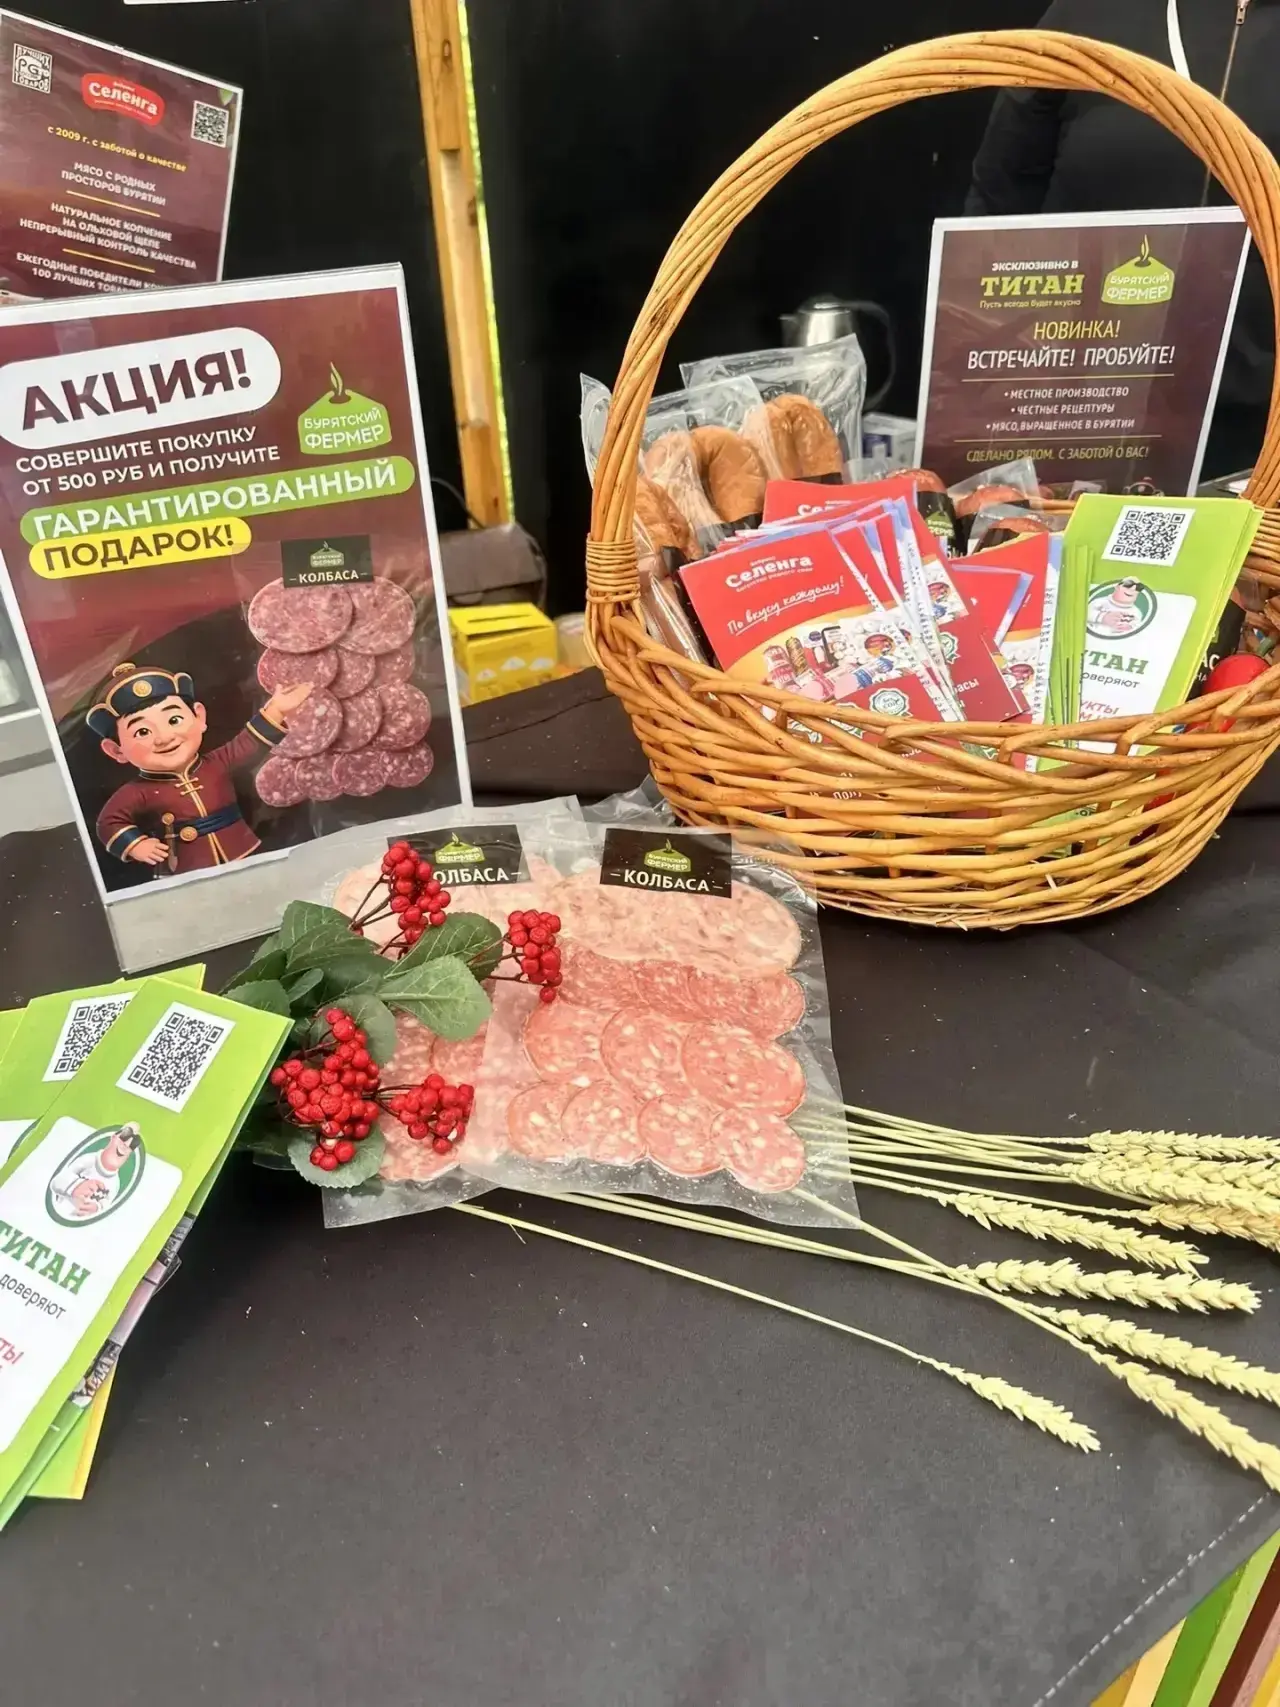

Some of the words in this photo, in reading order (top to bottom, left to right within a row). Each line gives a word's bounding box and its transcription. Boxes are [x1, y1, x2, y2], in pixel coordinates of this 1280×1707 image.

[89, 82, 158, 115] Селенга
[47, 126, 54, 134] с
[56, 127, 81, 141] 2009
[82, 136, 90, 145] г.
[92, 139, 99, 147] с
[100, 141, 137, 158] заботой
[138, 152, 145, 160] о
[147, 155, 187, 172] качестве
[61, 170, 121, 194] ПРОСТОРОВ
[123, 187, 166, 206] БУРЯТИИ
[74, 162, 103, 177] МЯСО
[105, 171, 113, 180] С
[114, 173, 156, 192] РОДНЫХ
[51, 203, 121, 227] НАТУРАЛЬНОЕ
[123, 221, 172, 241] КОПЧЕНИЕ
[62, 217, 77, 227] НА
[79, 221, 132, 241] ОЛЬХОВОЙ
[134, 235, 160, 249] ЩЕПЕ
[19, 218, 95, 244] НЕПРЕРЫВНЫЙ
[97, 238, 149, 258] КОНТРОЛЬ
[151, 250, 197, 270] КАЧЕСТВА
[16, 252, 78, 274] ЕЖЕГОДНЫЕ
[79, 267, 142, 289] ПОБЕДИТЕЛИ
[32, 267, 51, 279] 100
[52, 272, 96, 289] ЛУЧШИХ
[992, 261, 1069, 272] ЭКСКЛЮЗИВНО
[1070, 260, 1079, 270] В
[1110, 272, 1170, 285] БУРЯТСКИЙ
[980, 274, 1086, 297] ТИТАН
[1106, 286, 1168, 301] ФЕРМЕР
[979, 300, 1002, 310] Пусть
[1033, 319, 1121, 341] НОВИНКА!
[967, 346, 1075, 369] ВСТРЕЧАЙТЕ!
[1083, 343, 1176, 366] ПРОБУЙТЕ!
[22, 347, 252, 431] АКЦИЯ!
[1010, 388, 1054, 400] МЕСТНОЕ
[1055, 387, 1130, 399] ПРОИЗВОДСТВО
[304, 407, 382, 430] БУРЯТСКИЙ
[1017, 405, 1059, 415] ЧЕСТНЫЕ
[1061, 403, 1116, 415] РЕЦЕПТУРЫ
[1085, 420, 1092, 429] В
[1093, 418, 1136, 430] БУРЯТИИ
[15, 441, 154, 474] СОВЕРШИТЕ
[159, 425, 257, 454] ПОКУПКУ
[305, 425, 385, 450] ФЕРМЕР
[966, 449, 1014, 463] СДЕЛАНО
[1058, 450, 1066, 460] С
[1067, 445, 1114, 460] ЗАБОТОЙ
[1115, 448, 1123, 458] О
[1125, 446, 1150, 459] ВАС!
[22, 478, 52, 498] ОТ
[58, 472, 97, 492] 500
[103, 464, 144, 486] РУБ
[150, 461, 165, 478] И
[170, 445, 281, 475] ПОЛУЧИТЕ
[33, 457, 397, 541] ГАРАНТИРОВАННЫЙ
[44, 523, 235, 572] ПОДАРОК!
[299, 569, 359, 584] КОЛБАСА
[725, 556, 814, 588] Селенга
[727, 620, 744, 635] По
[745, 602, 780, 622] вкусу
[783, 575, 844, 603] каждому!
[1085, 650, 1149, 675] ТАН
[1081, 672, 1141, 689] оверяют
[432, 867, 510, 885] ОЛБАСА
[647, 859, 688, 871] ФЕРМЕР
[623, 868, 710, 892] КОЛБАСА
